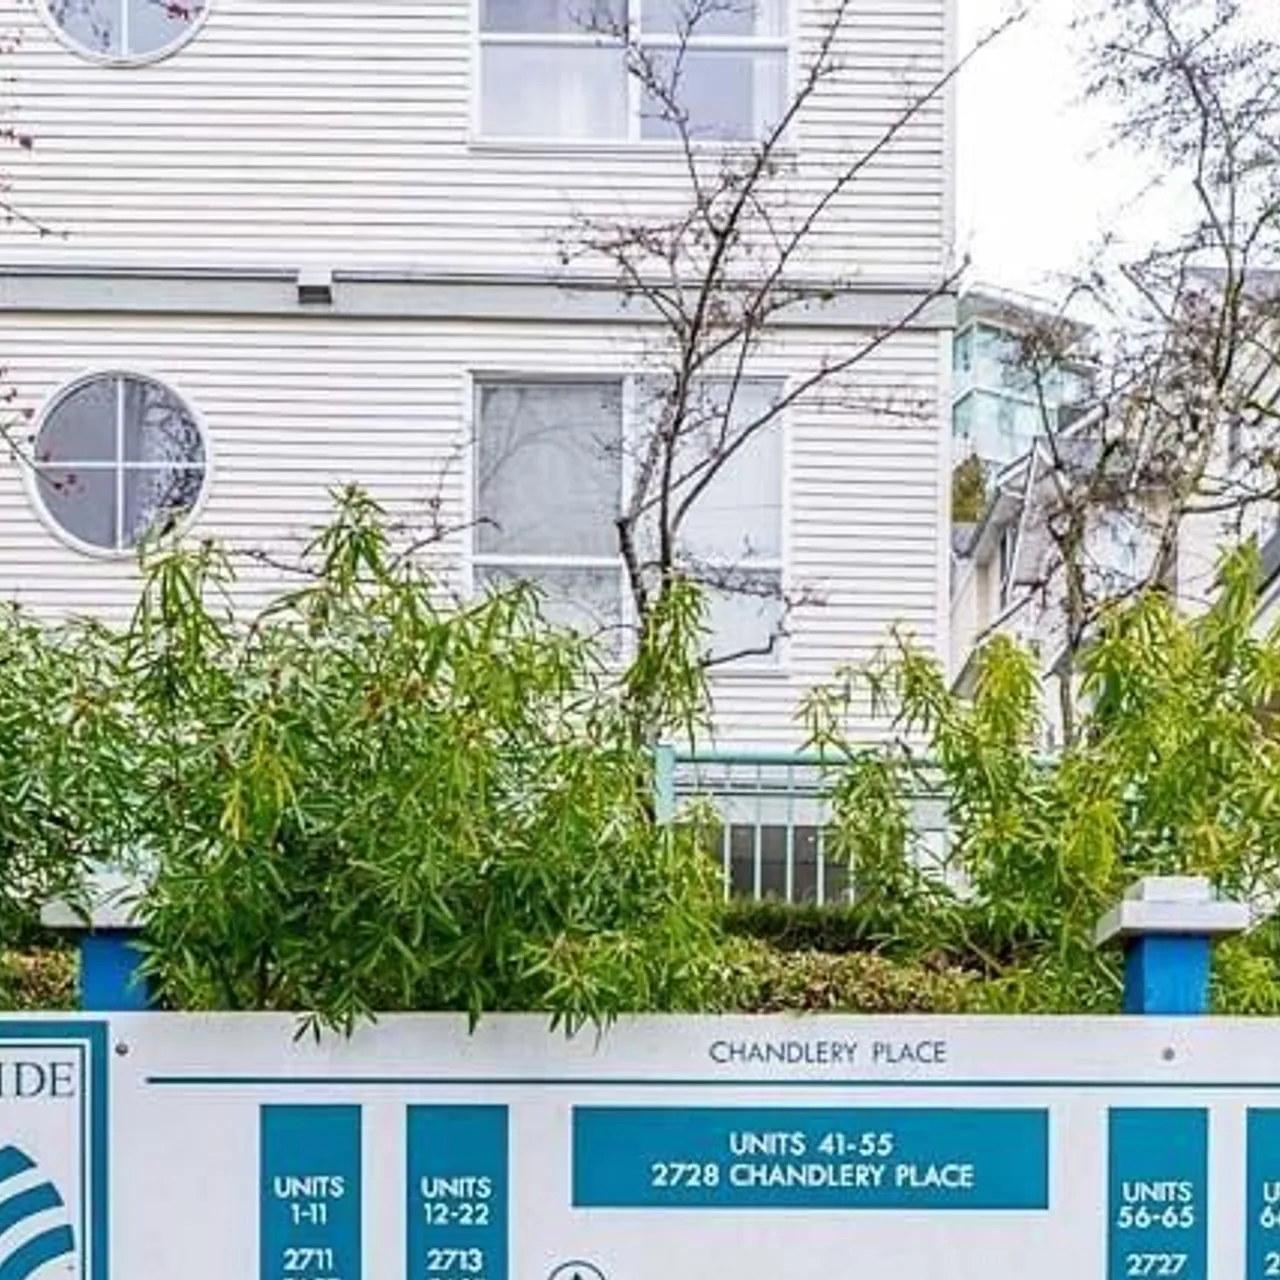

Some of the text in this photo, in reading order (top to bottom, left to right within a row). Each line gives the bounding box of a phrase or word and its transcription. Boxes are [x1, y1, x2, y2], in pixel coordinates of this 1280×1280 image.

[709, 1040, 947, 1065] CHANDLERY PLACE
[729, 1132, 894, 1156] UNITS 41-55
[651, 1164, 975, 1188] 2728 CHANDLERY PLACE
[274, 1176, 345, 1199] UNITS
[421, 1176, 492, 1199] UNITS
[1123, 1182, 1193, 1203] UNITS
[291, 1204, 327, 1225] 1-11
[424, 1204, 490, 1226] 12-22
[1118, 1207, 1194, 1229] 56-65
[282, 1249, 334, 1271] 2711
[427, 1249, 484, 1272] 2713
[1126, 1254, 1188, 1276] 2727
